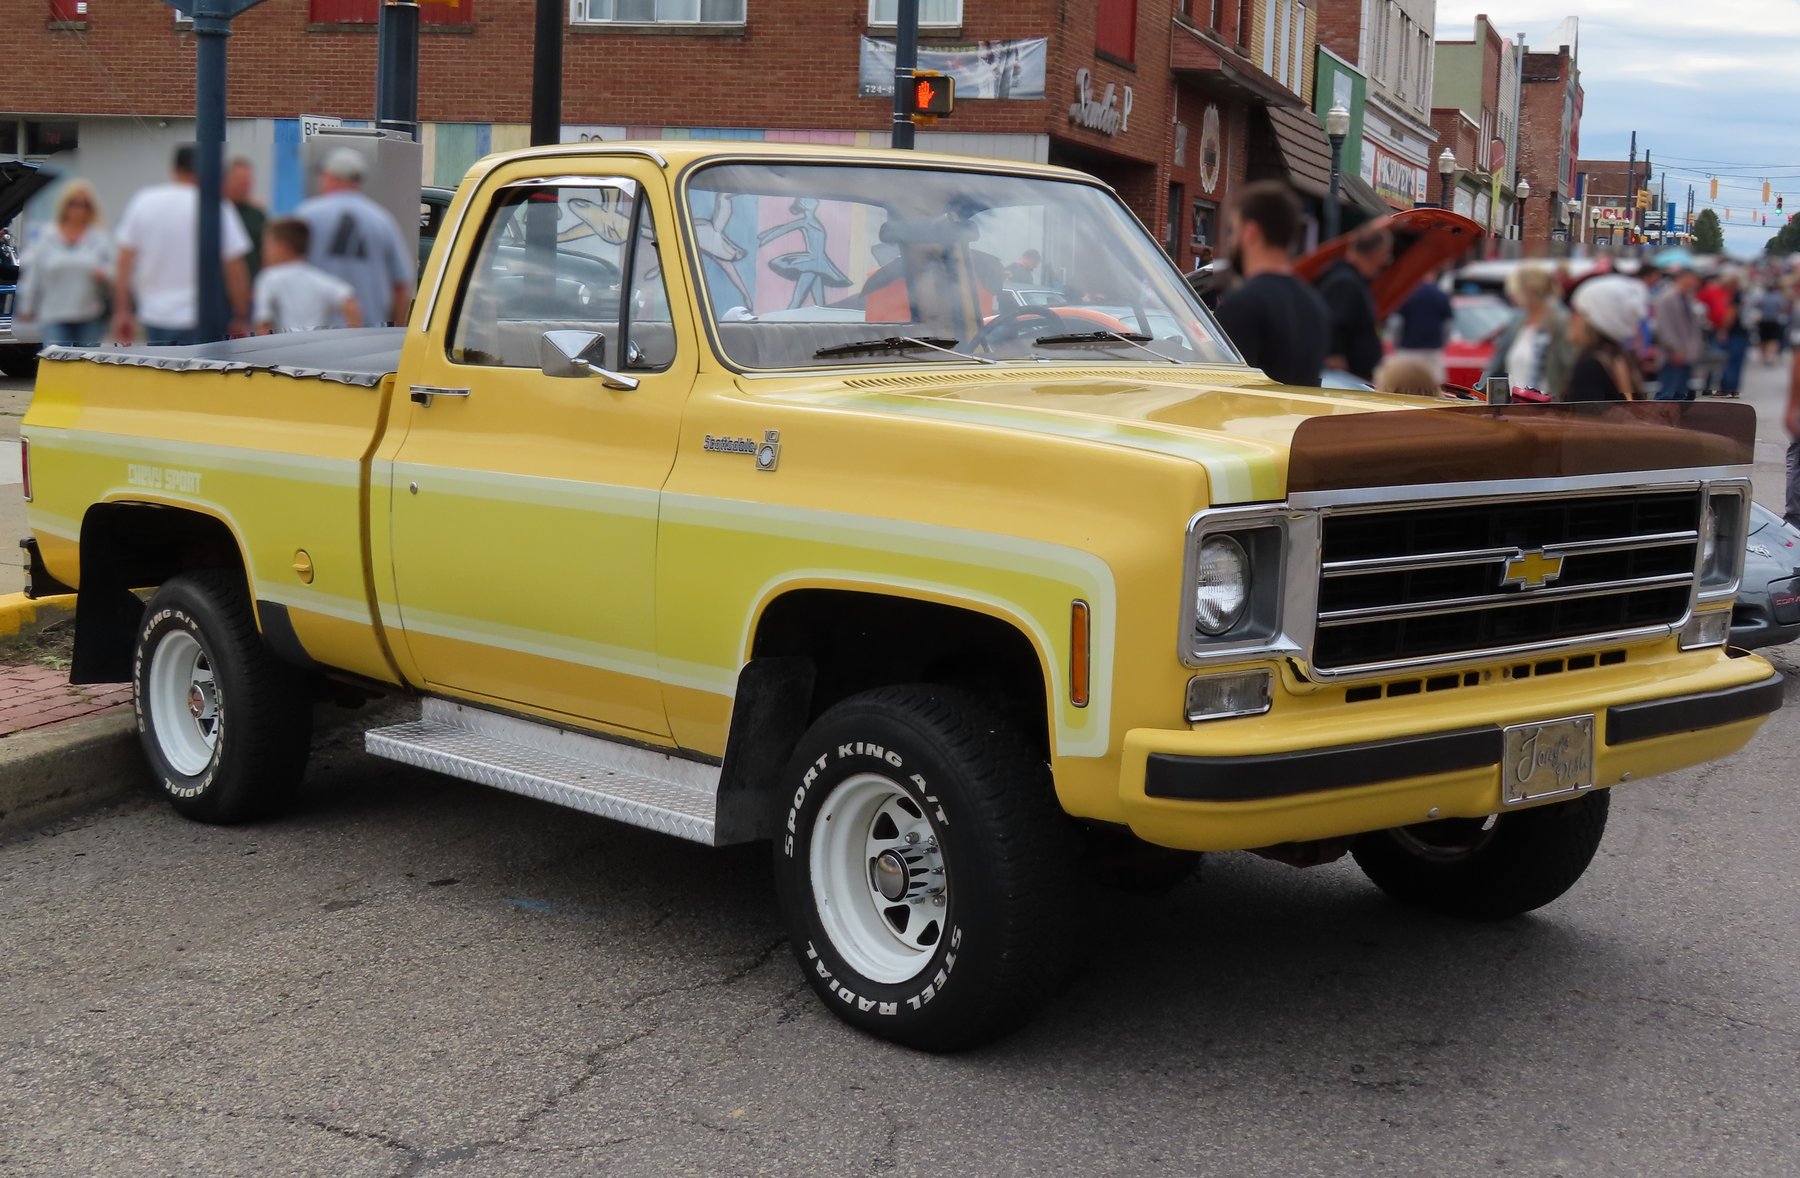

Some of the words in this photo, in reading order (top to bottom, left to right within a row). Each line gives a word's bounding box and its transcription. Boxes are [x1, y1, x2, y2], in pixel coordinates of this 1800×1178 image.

[1121, 85, 1133, 132] P
[703, 434, 757, 455] Scottsdale
[128, 464, 162, 488] CHEVY
[165, 468, 202, 494] SPORT
[135, 645, 145, 733] SPORT
[144, 609, 172, 642] KING
[164, 771, 214, 798] RADIAL
[784, 753, 829, 858] SPORT
[838, 741, 903, 767] KING
[909, 773, 950, 826] A/T
[806, 940, 898, 1016] RADIAL
[907, 924, 962, 1011] STEEL
